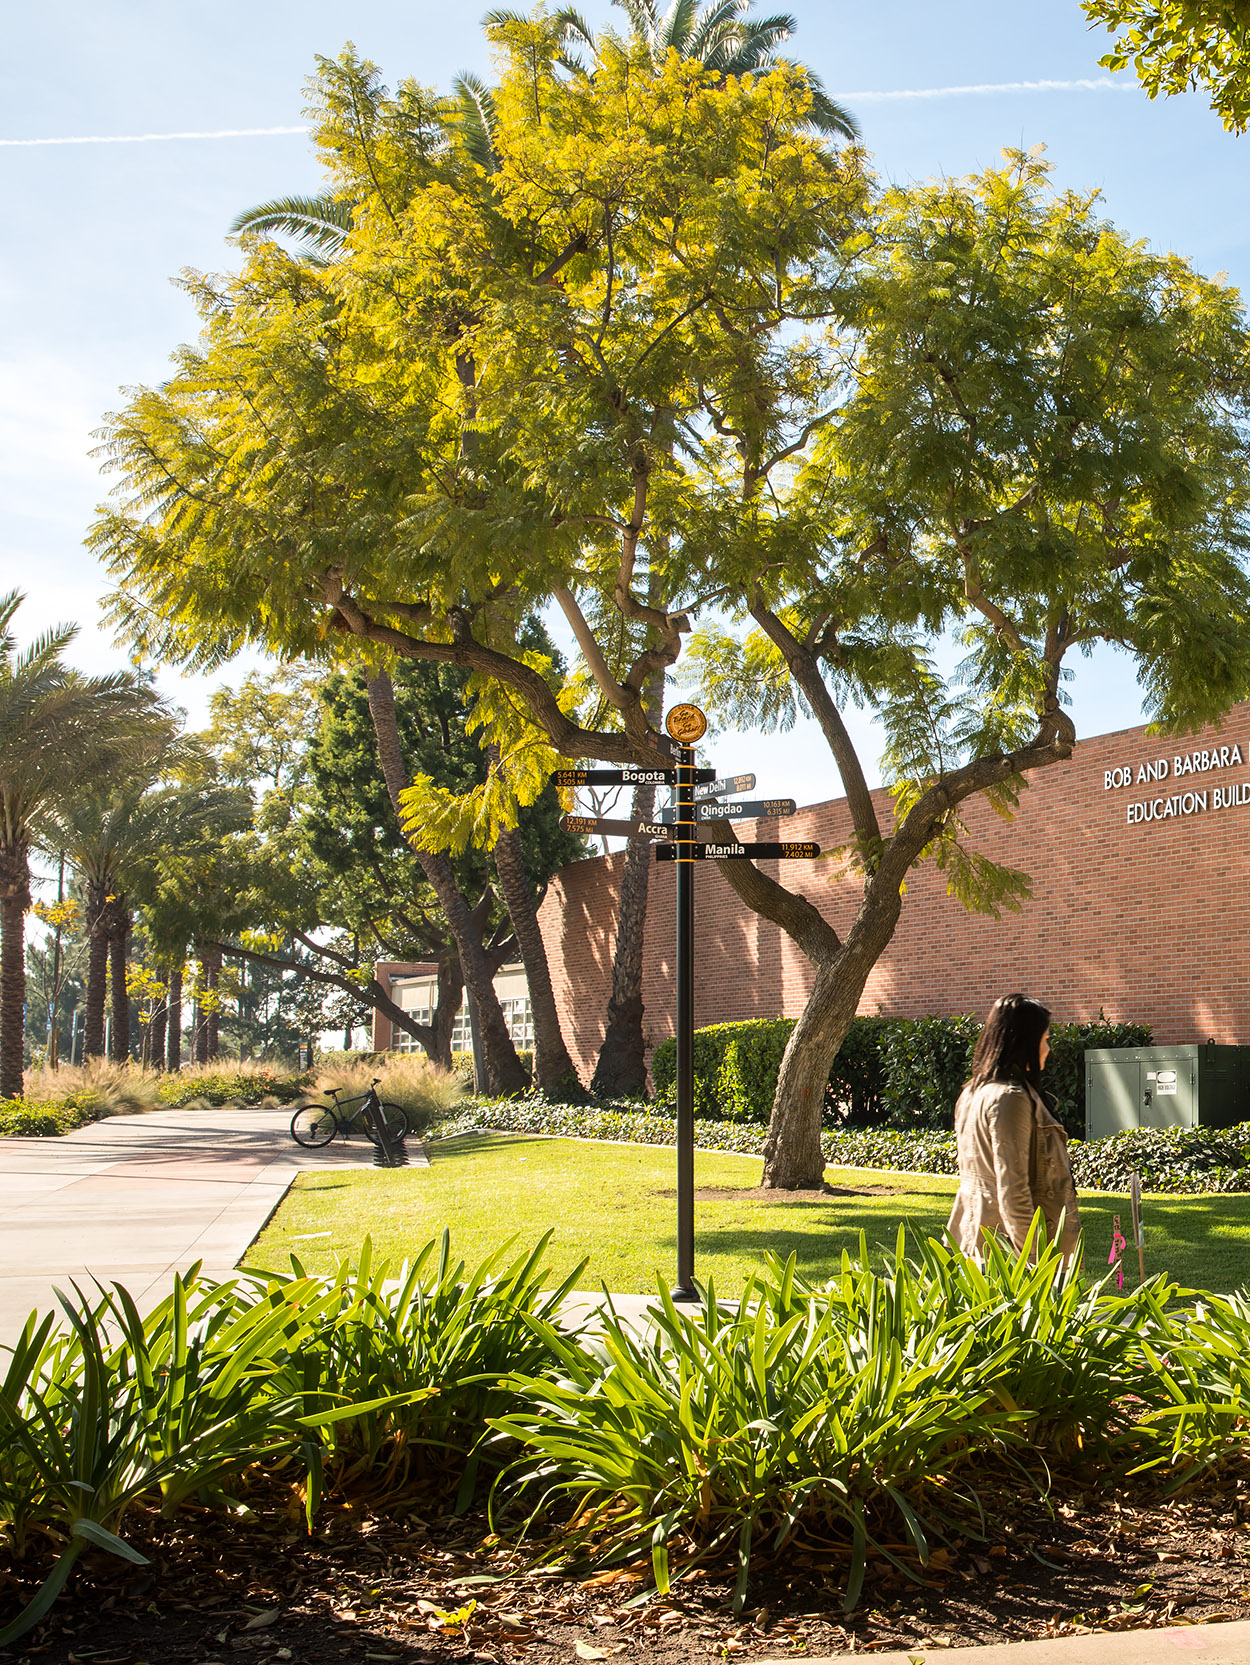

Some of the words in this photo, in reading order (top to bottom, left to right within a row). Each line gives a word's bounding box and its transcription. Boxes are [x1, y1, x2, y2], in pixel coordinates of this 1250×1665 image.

[1104, 767, 1131, 790] BOB
[1136, 759, 1169, 784] AND
[1174, 744, 1242, 776] BARBARA
[622, 771, 665, 783] Bogota
[694, 785, 708, 796] New
[709, 780, 726, 794] Delhi
[701, 804, 742, 817] Qingdao
[1127, 791, 1209, 824] EDUCATION
[638, 823, 667, 834] Accra
[705, 844, 745, 855] Manila
